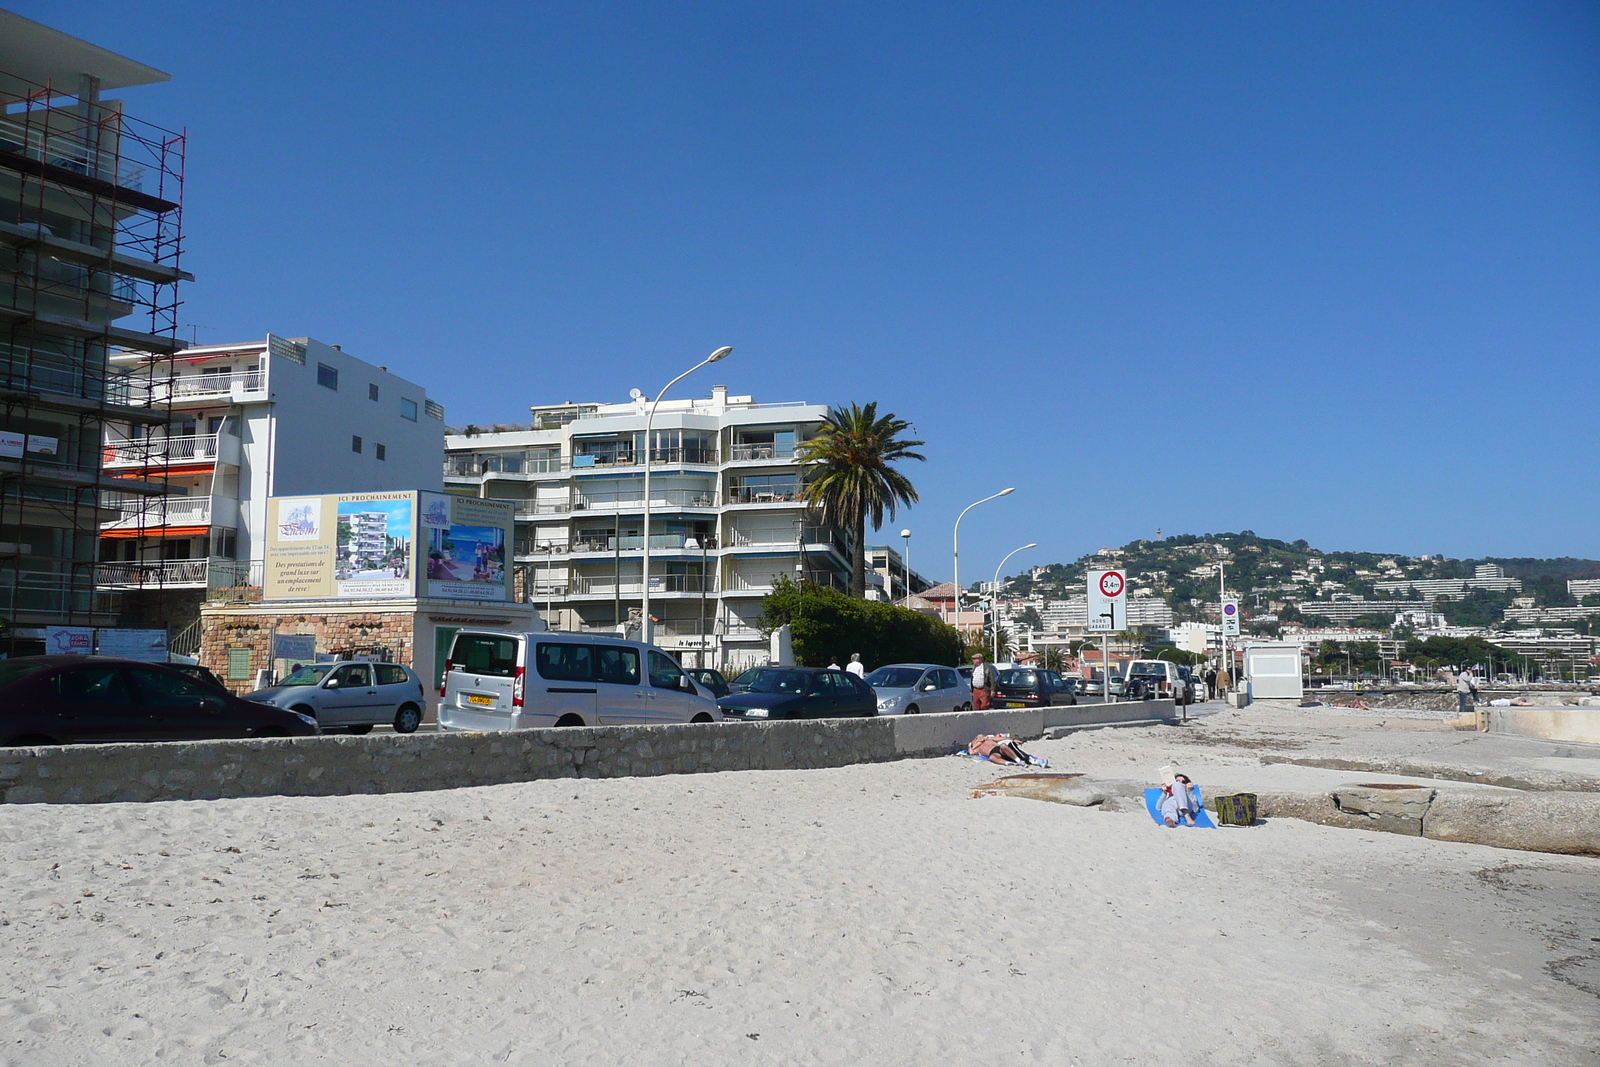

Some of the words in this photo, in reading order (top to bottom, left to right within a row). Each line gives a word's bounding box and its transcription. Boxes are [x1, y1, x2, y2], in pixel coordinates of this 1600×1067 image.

[352, 493, 412, 501] PROCHAINEMENT
[466, 499, 510, 510] PROCHAINEMENT
[287, 561, 317, 569] prestations
[285, 577, 322, 585] emplacement
